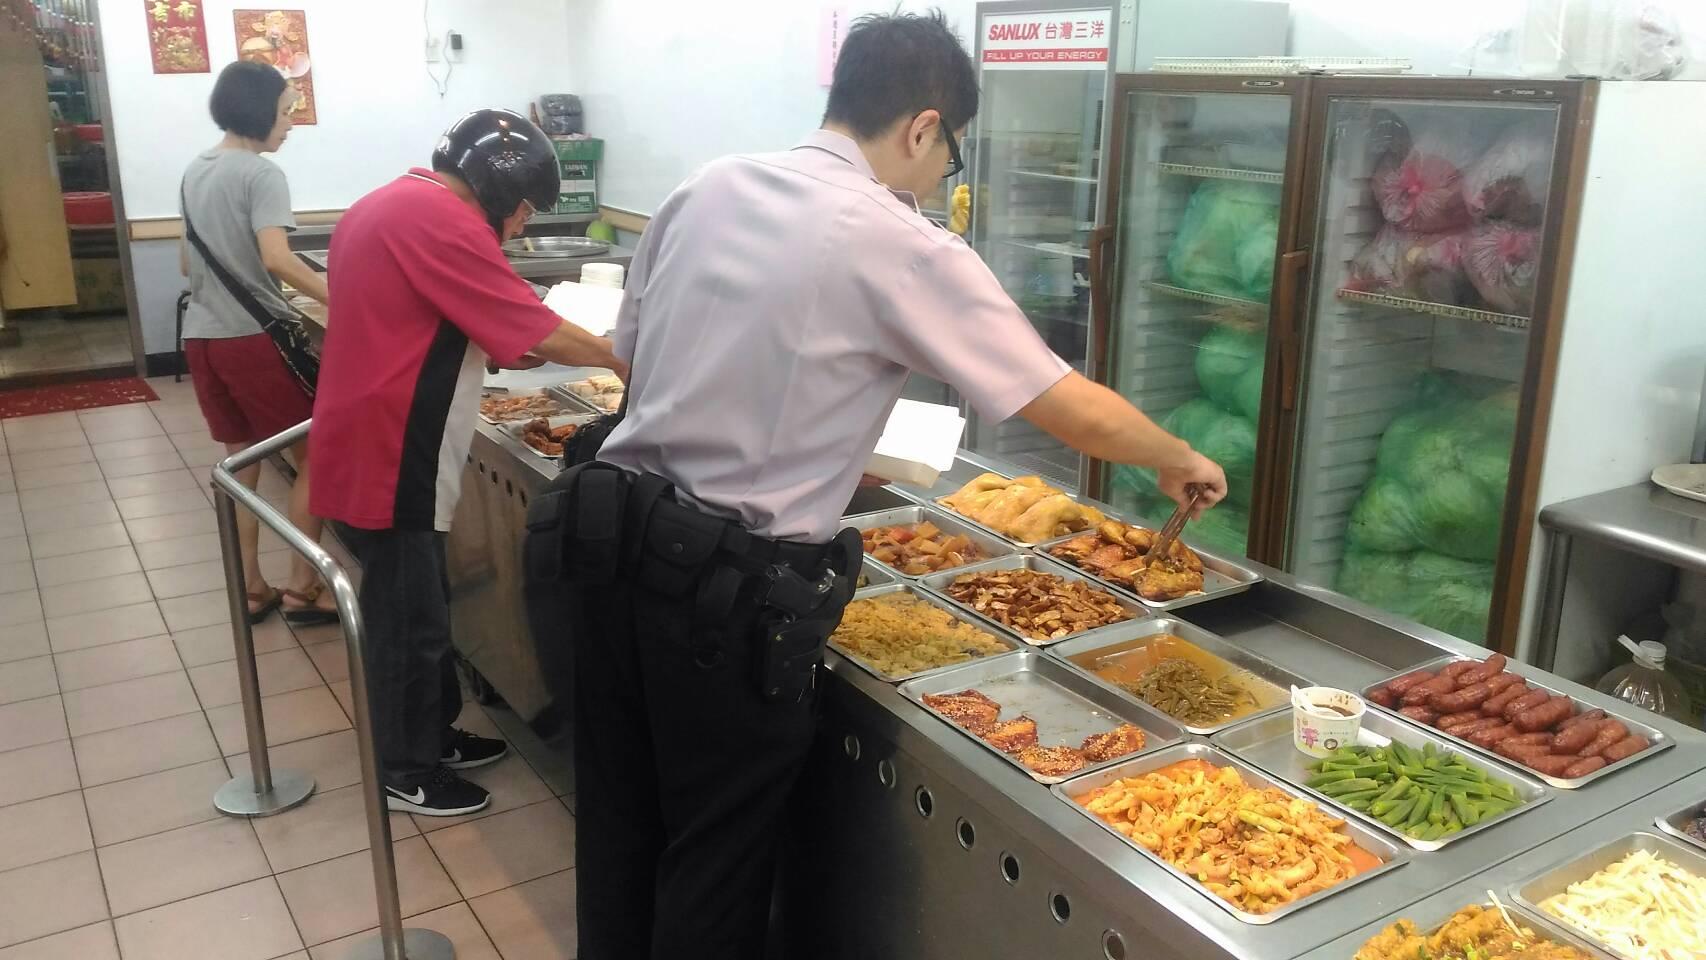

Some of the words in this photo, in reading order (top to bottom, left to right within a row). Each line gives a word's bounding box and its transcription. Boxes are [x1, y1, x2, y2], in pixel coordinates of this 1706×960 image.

[988, 23, 1042, 41] SANLUX
[1045, 20, 1104, 40] 台灣三洋
[986, 52, 1007, 60] FILL
[1009, 52, 1023, 60] UP
[1026, 51, 1054, 60] YOUR
[1057, 51, 1104, 60] ENERGY
